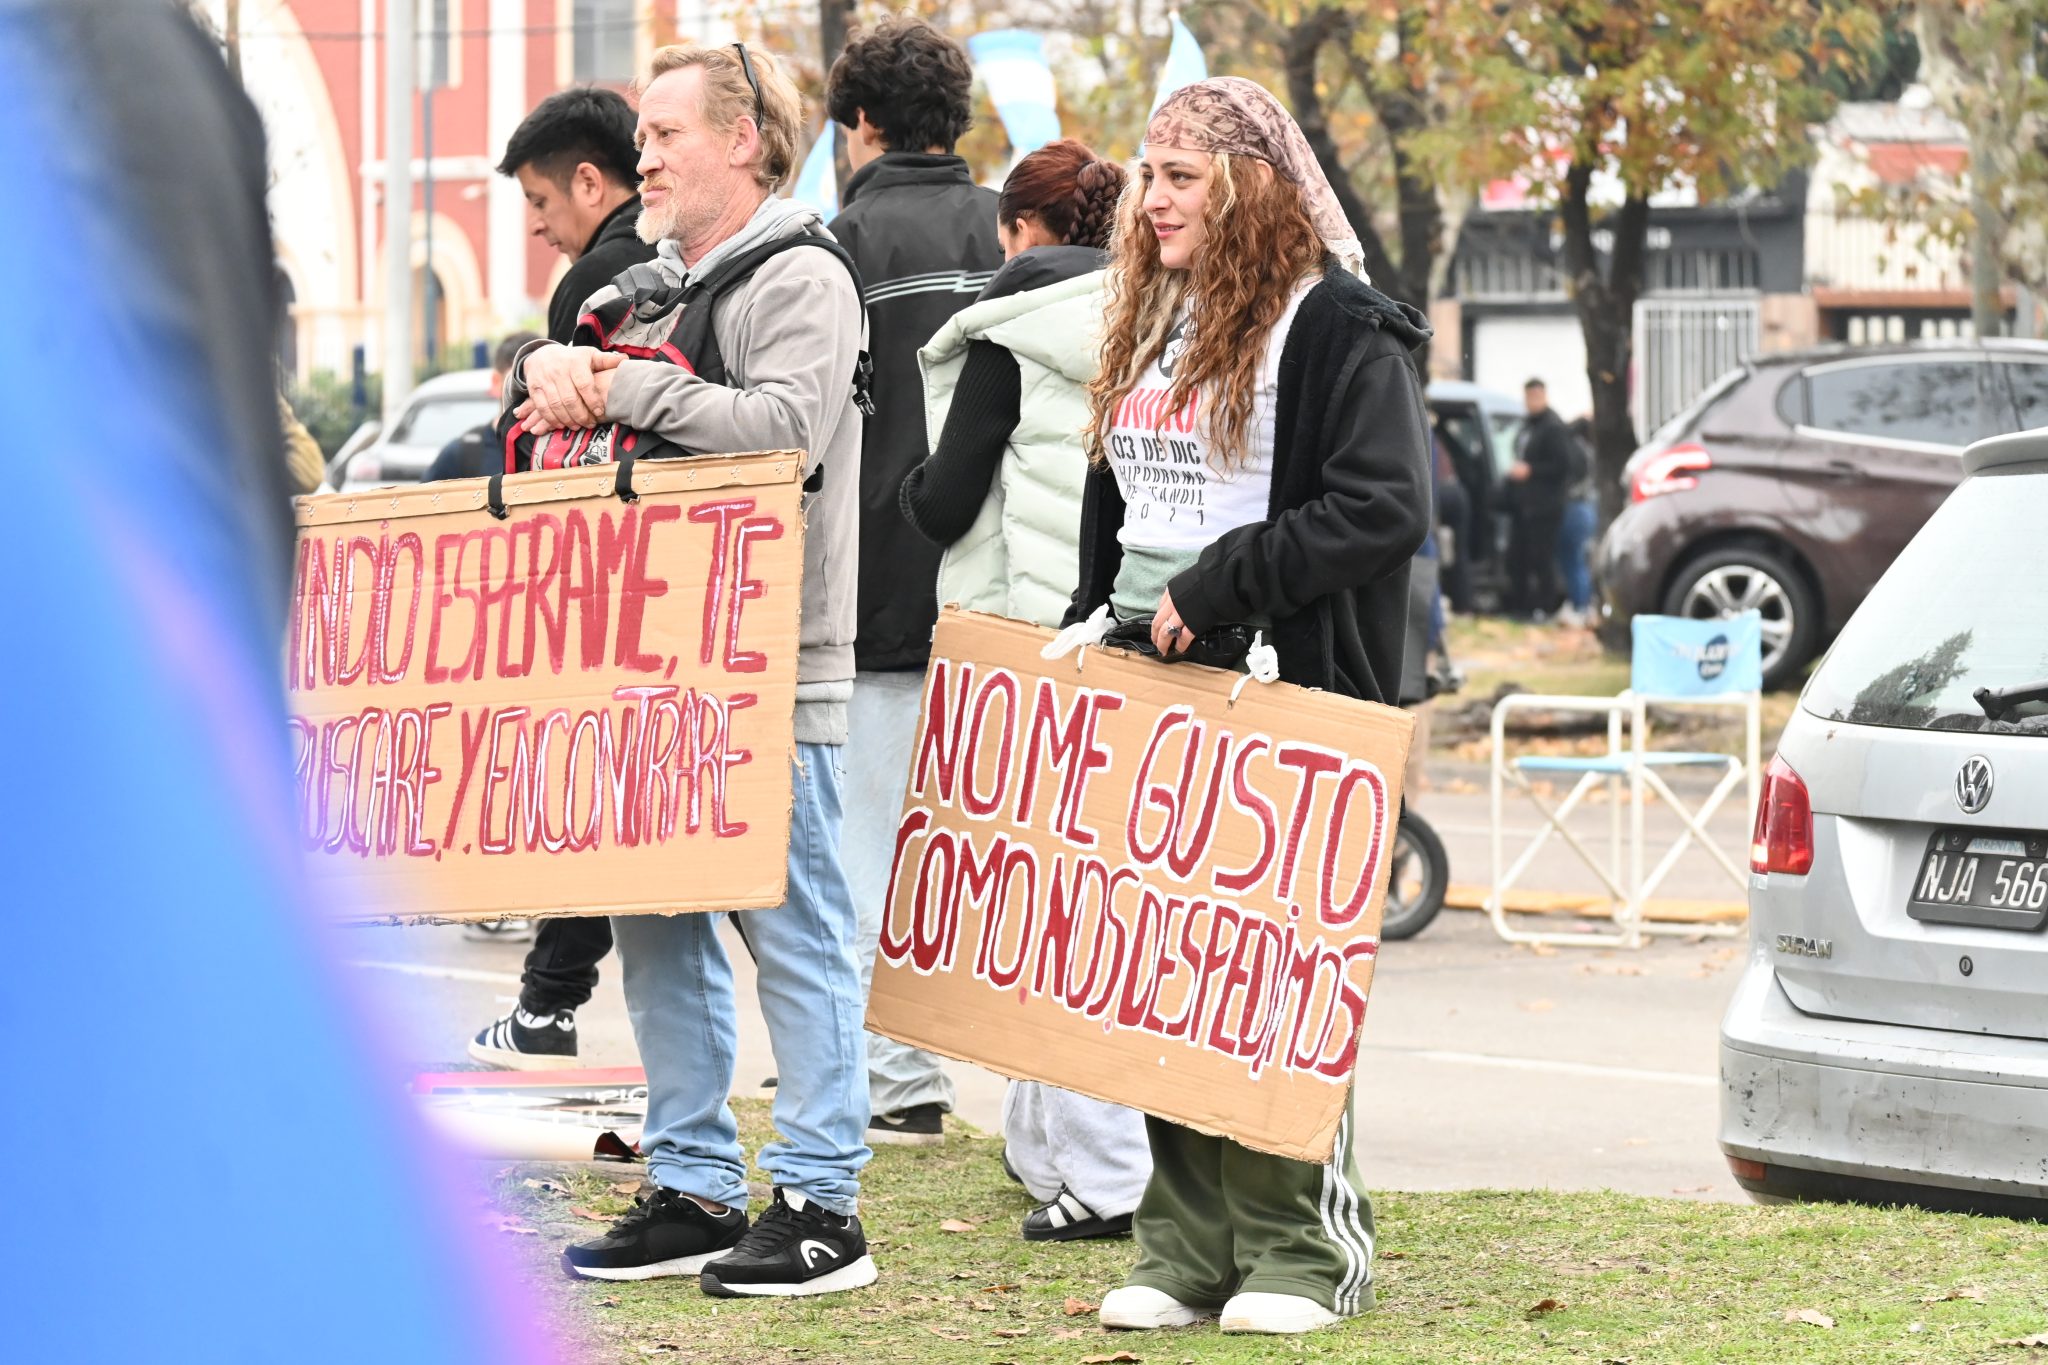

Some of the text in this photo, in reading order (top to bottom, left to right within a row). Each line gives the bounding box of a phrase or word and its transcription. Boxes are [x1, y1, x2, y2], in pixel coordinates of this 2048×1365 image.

[1111, 433, 1201, 466] 03 DE DIC
[1148, 485, 1205, 506] TANDIL
[688, 496, 785, 674] TE
[479, 684, 758, 858] ENCONTRARE
[912, 658, 1388, 930] NO ME GUSTO
[878, 806, 1040, 991] COMO
[1918, 853, 2048, 909] NJA 566
[1775, 933, 1833, 960] SURAN
